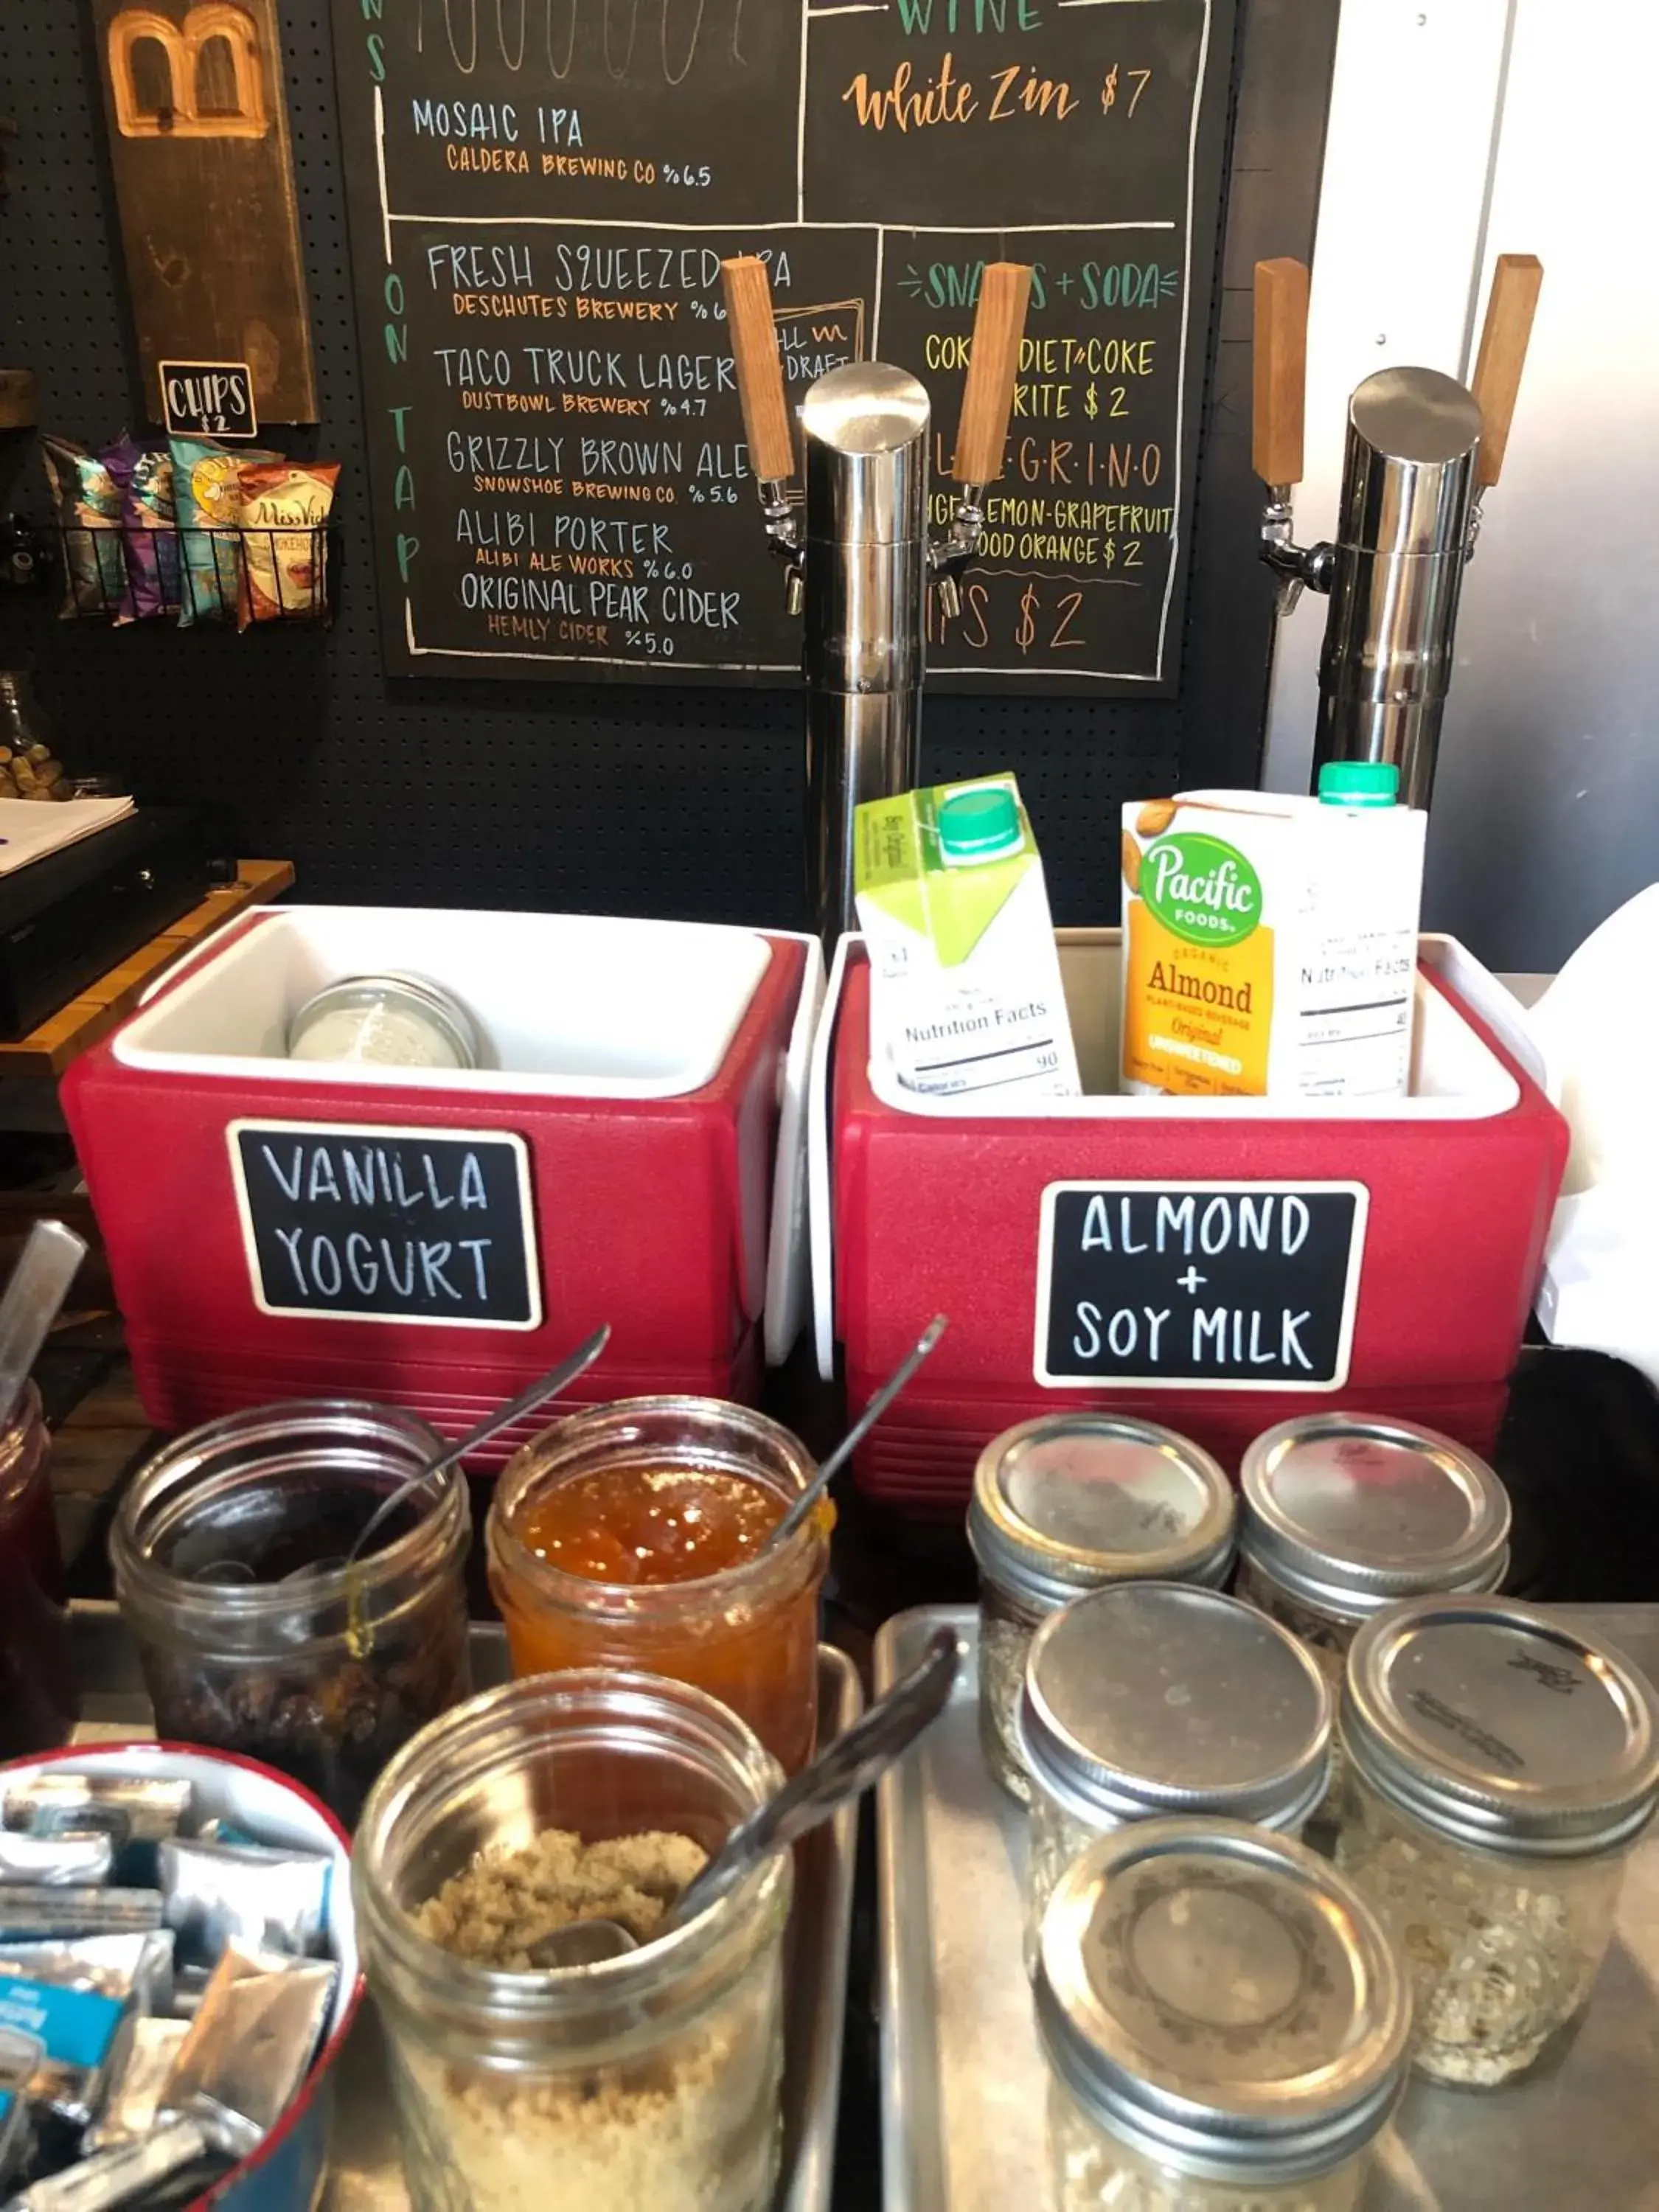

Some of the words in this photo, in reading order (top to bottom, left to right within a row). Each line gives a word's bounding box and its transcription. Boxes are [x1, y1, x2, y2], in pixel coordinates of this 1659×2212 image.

[897, 0, 1042, 35] WINE
[108, 3, 270, 139] B
[842, 52, 978, 133] White
[989, 66, 1079, 122] Zin
[1101, 63, 1151, 119] $7
[412, 99, 518, 142] MOSAIC
[538, 107, 582, 147] IPA
[446, 145, 529, 174] CALDERA
[542, 154, 627, 180] BREWING
[634, 160, 655, 184] CO
[428, 244, 533, 291] FRESH
[555, 244, 721, 292] SQUEEZED
[738, 249, 791, 288] PA
[925, 261, 1047, 310] SNAS
[1081, 261, 1159, 310] SODA
[384, 273, 408, 364] ON
[453, 294, 567, 319] DESCHUTES
[576, 296, 679, 321] BREWERY
[434, 348, 511, 387] TACO
[523, 347, 626, 388] TRUCK
[638, 354, 737, 392] LAGER
[925, 334, 970, 369] COK
[1088, 338, 1156, 375] COKE
[168, 374, 246, 418] CHIPS
[462, 391, 554, 413] DUSTBOWL
[563, 393, 651, 417] BREWERY
[1013, 383, 1072, 418] RITE
[201, 414, 231, 433] $2
[447, 431, 565, 474] GRIZZLY
[580, 437, 682, 476] BROWN
[696, 442, 750, 479] ALE
[388, 406, 420, 583] TAP
[473, 475, 563, 495] SNOWSHOE
[572, 481, 651, 501] BREWING
[254, 501, 301, 526] Miss
[456, 507, 535, 546] ALIBI
[555, 515, 672, 554] PORTER
[476, 548, 518, 566] ALIBI
[529, 552, 562, 572] ALE
[568, 554, 634, 579] WORKS
[978, 531, 1015, 559] OOD
[1020, 532, 1099, 565] ORANGE
[461, 573, 581, 615] ORIGINAL
[590, 580, 650, 625] PEAR
[662, 586, 740, 629] CIDER
[488, 614, 551, 641] HEMLY
[559, 621, 609, 646] CIDER
[1148, 844, 1254, 913] Pacific
[1175, 909, 1231, 931] FOODS
[1147, 960, 1253, 1015] Almond
[905, 1015, 989, 1043] Nutrition
[994, 1001, 1047, 1026] Facts
[261, 1144, 487, 1210] VANILLA
[1081, 1194, 1310, 1256] ALMOND
[275, 1227, 492, 1300] YOGURT
[1073, 1301, 1170, 1363] SOY
[1192, 1307, 1314, 1370] MILK
